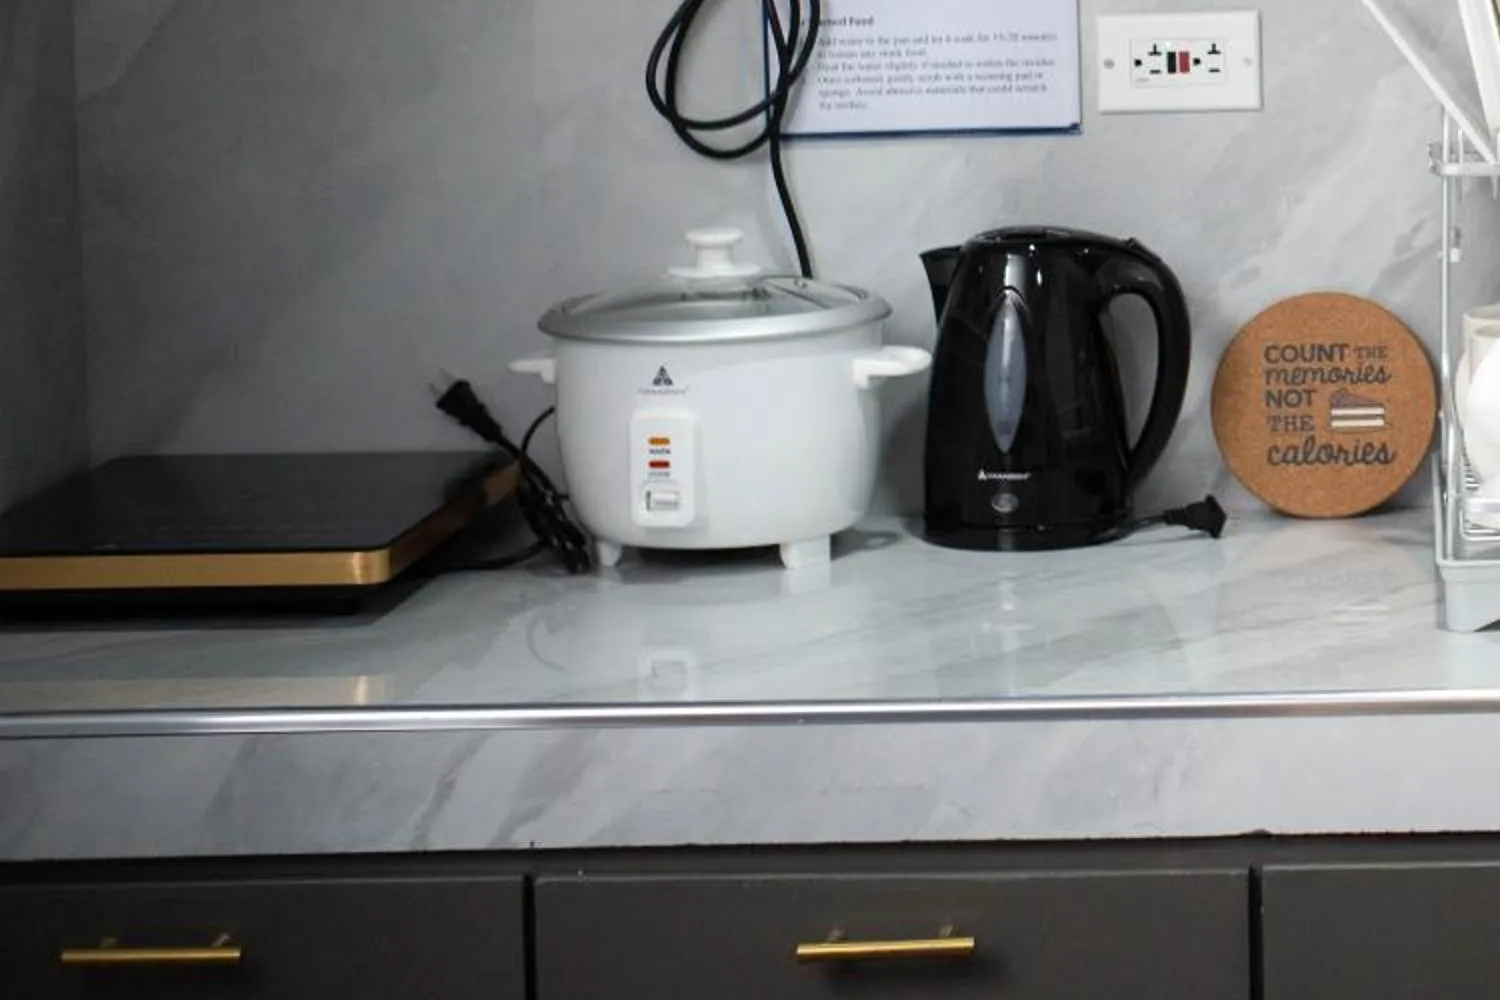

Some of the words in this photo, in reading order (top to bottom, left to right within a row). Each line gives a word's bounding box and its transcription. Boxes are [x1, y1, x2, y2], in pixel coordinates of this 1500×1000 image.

[1264, 344, 1349, 363] COUNT
[1354, 345, 1388, 360] THE
[1264, 364, 1392, 386] memories
[1265, 389, 1317, 409] NOT
[1268, 415, 1315, 433] THE
[1267, 435, 1396, 467] calories
